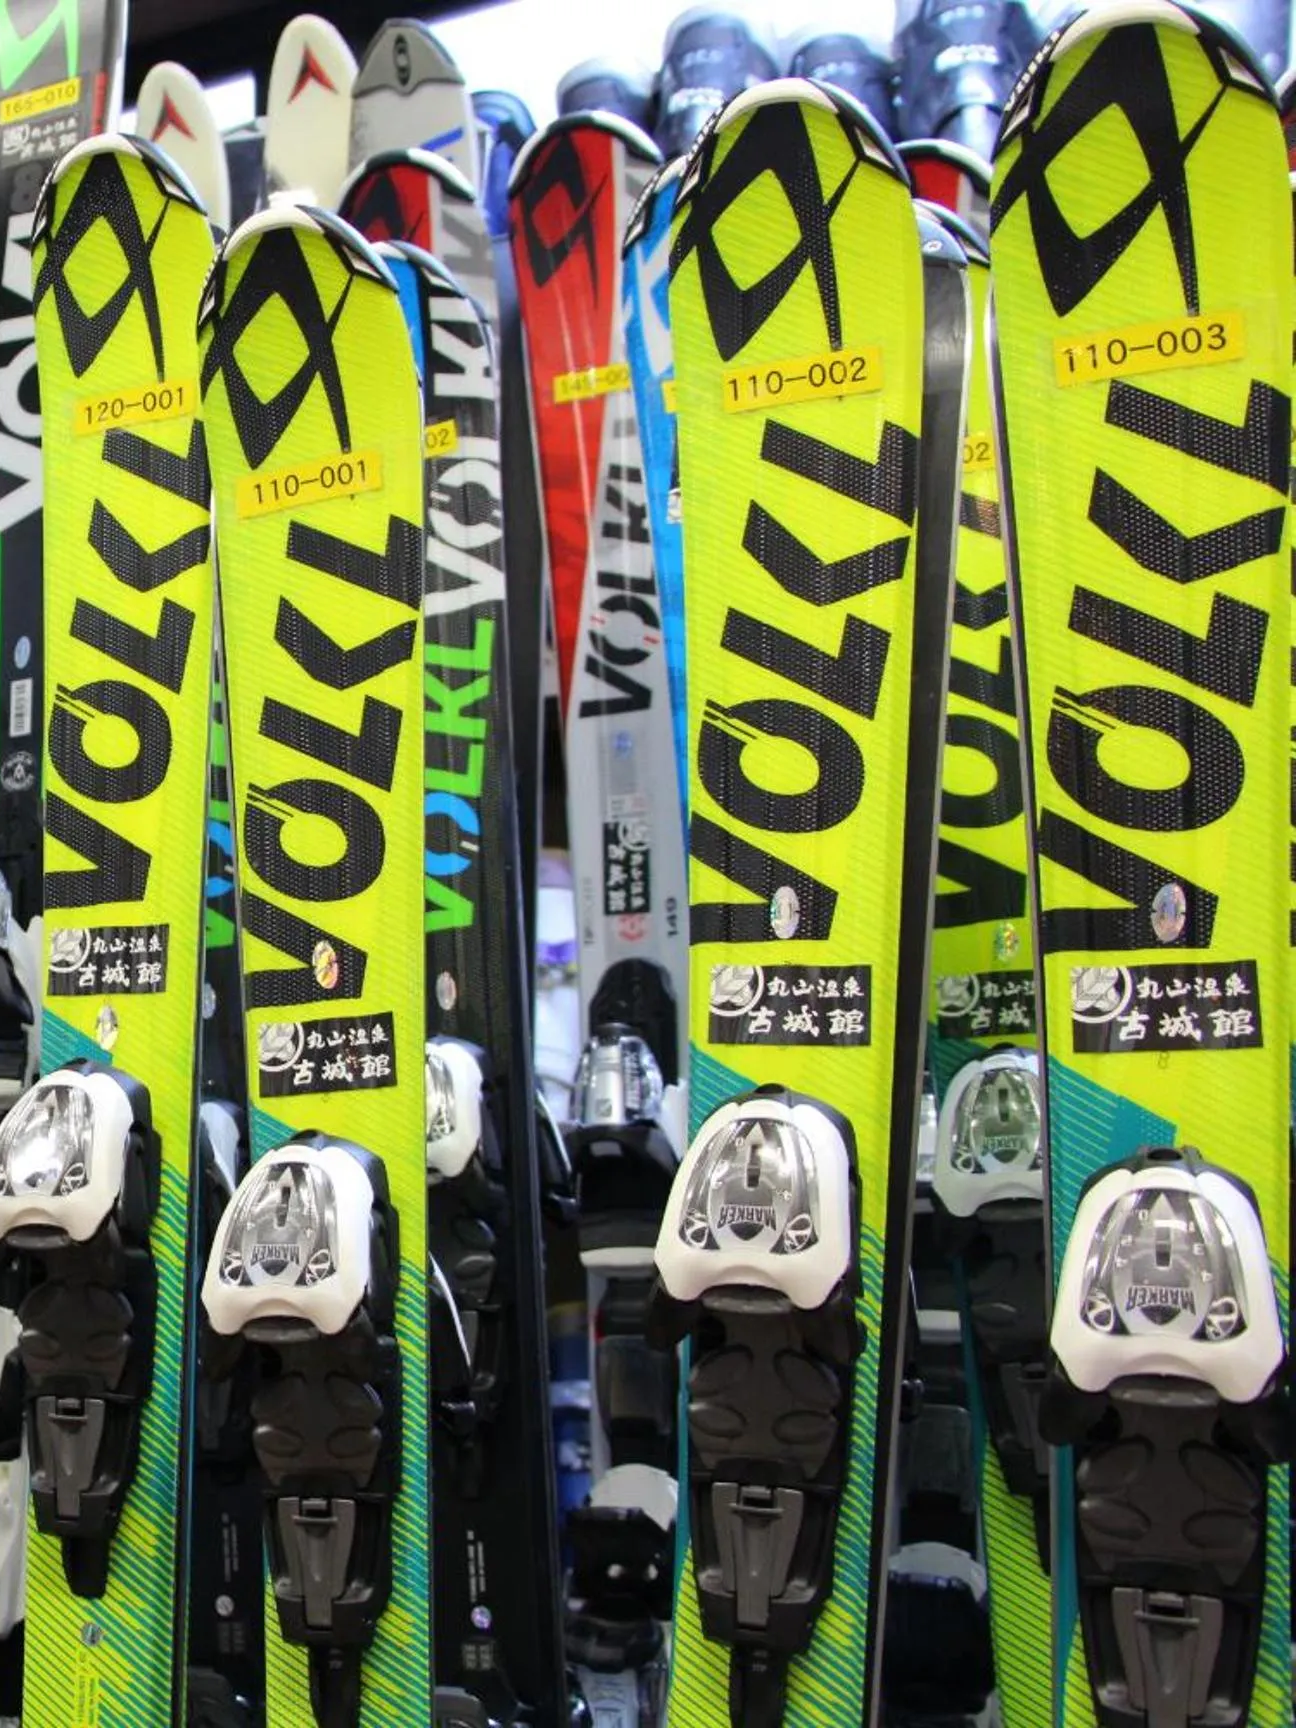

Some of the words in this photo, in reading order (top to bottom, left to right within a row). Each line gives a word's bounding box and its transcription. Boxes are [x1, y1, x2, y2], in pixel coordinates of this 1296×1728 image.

[1061, 323, 1227, 374] 110-003
[728, 356, 868, 402] 110-002
[83, 386, 185, 425] 120-001
[252, 458, 367, 504] 110-001
[766, 975, 865, 999] 丸山温泉
[1135, 972, 1252, 1000] 丸山温泉
[747, 1005, 866, 1036] 古城館
[1115, 1005, 1255, 1042] 古城館
[306, 1022, 390, 1051] 丸山温泉
[717, 1204, 777, 1231] MARKER
[251, 1244, 300, 1266] MARKER
[1125, 1285, 1197, 1316] MARKER
